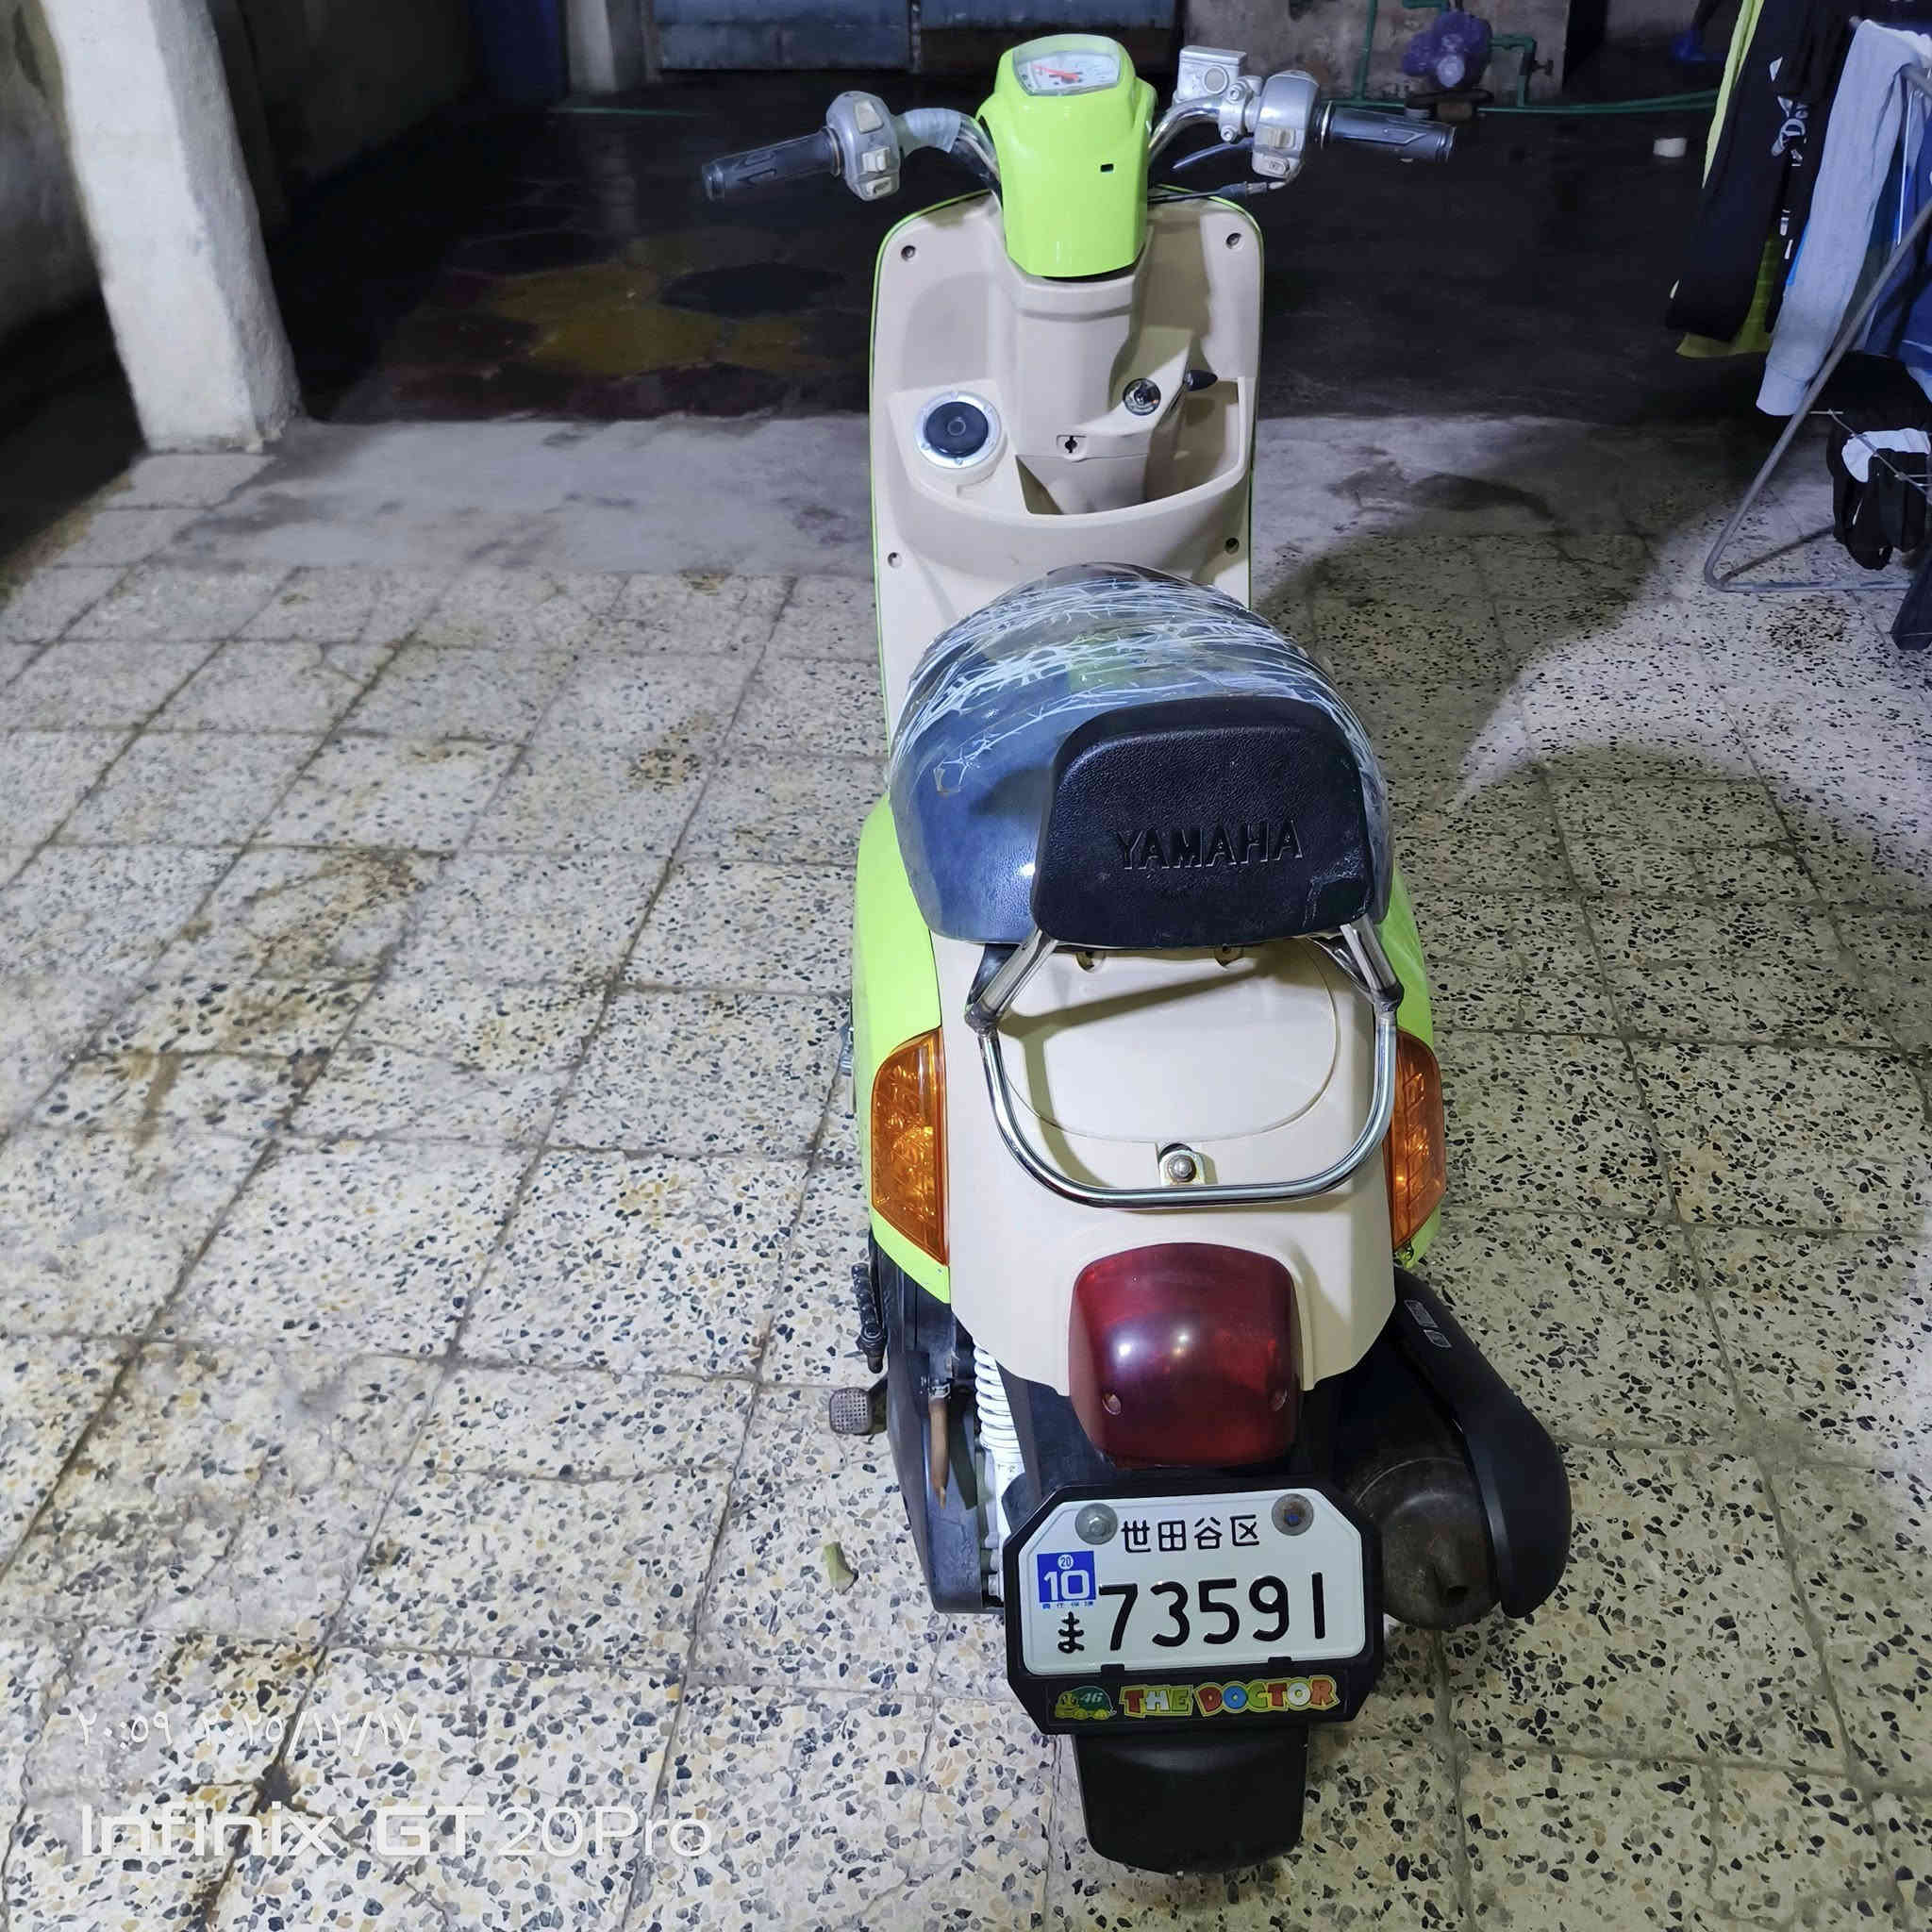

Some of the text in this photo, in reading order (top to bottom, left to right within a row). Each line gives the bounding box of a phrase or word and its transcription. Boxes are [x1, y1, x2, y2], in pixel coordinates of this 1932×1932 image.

[1115, 818, 1304, 871] YAMAHA
[1121, 1514, 1260, 1554] 世田谷区
[1059, 1556, 1073, 1568] 20
[1043, 1570, 1091, 1601] 10
[1098, 1571, 1326, 1652] 73591
[1058, 1611, 1085, 1654] ま
[1079, 1692, 1104, 1705] 46
[1121, 1675, 1340, 1718] THE DOCTOR
